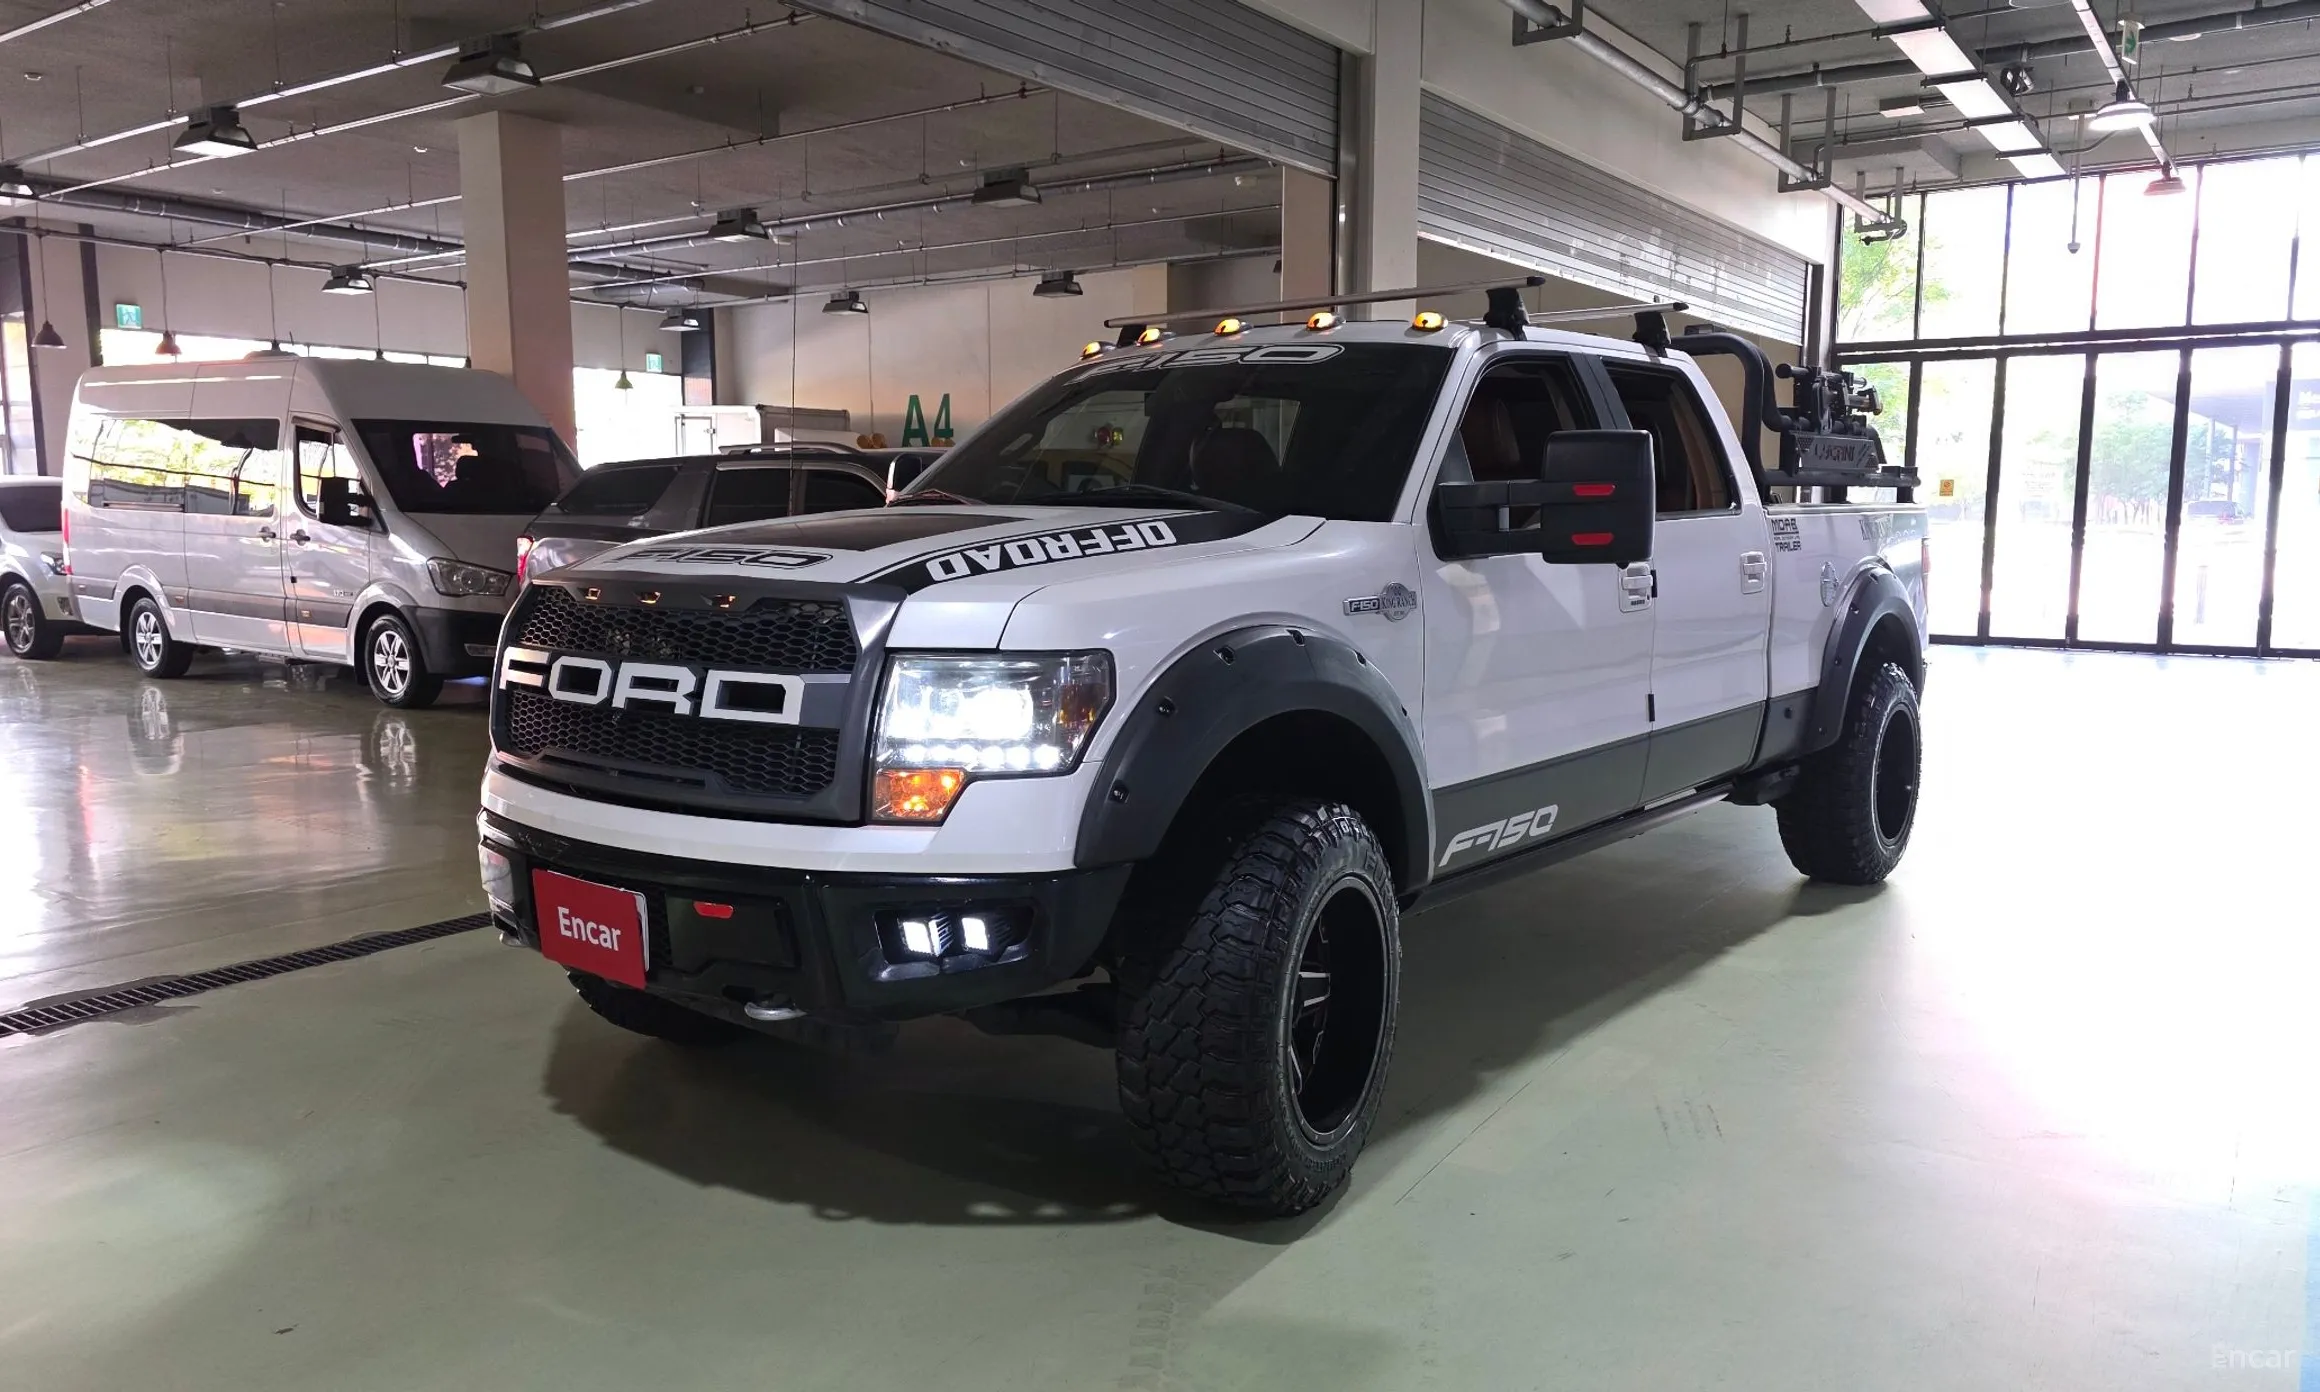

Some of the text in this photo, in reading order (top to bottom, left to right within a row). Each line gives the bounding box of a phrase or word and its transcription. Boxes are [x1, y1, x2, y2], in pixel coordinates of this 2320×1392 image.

[902, 393, 954, 447] A4
[926, 521, 1177, 582] OFFROAD
[1351, 599, 1379, 611] F-150
[499, 646, 805, 725] FORD
[557, 906, 621, 951] Encar
